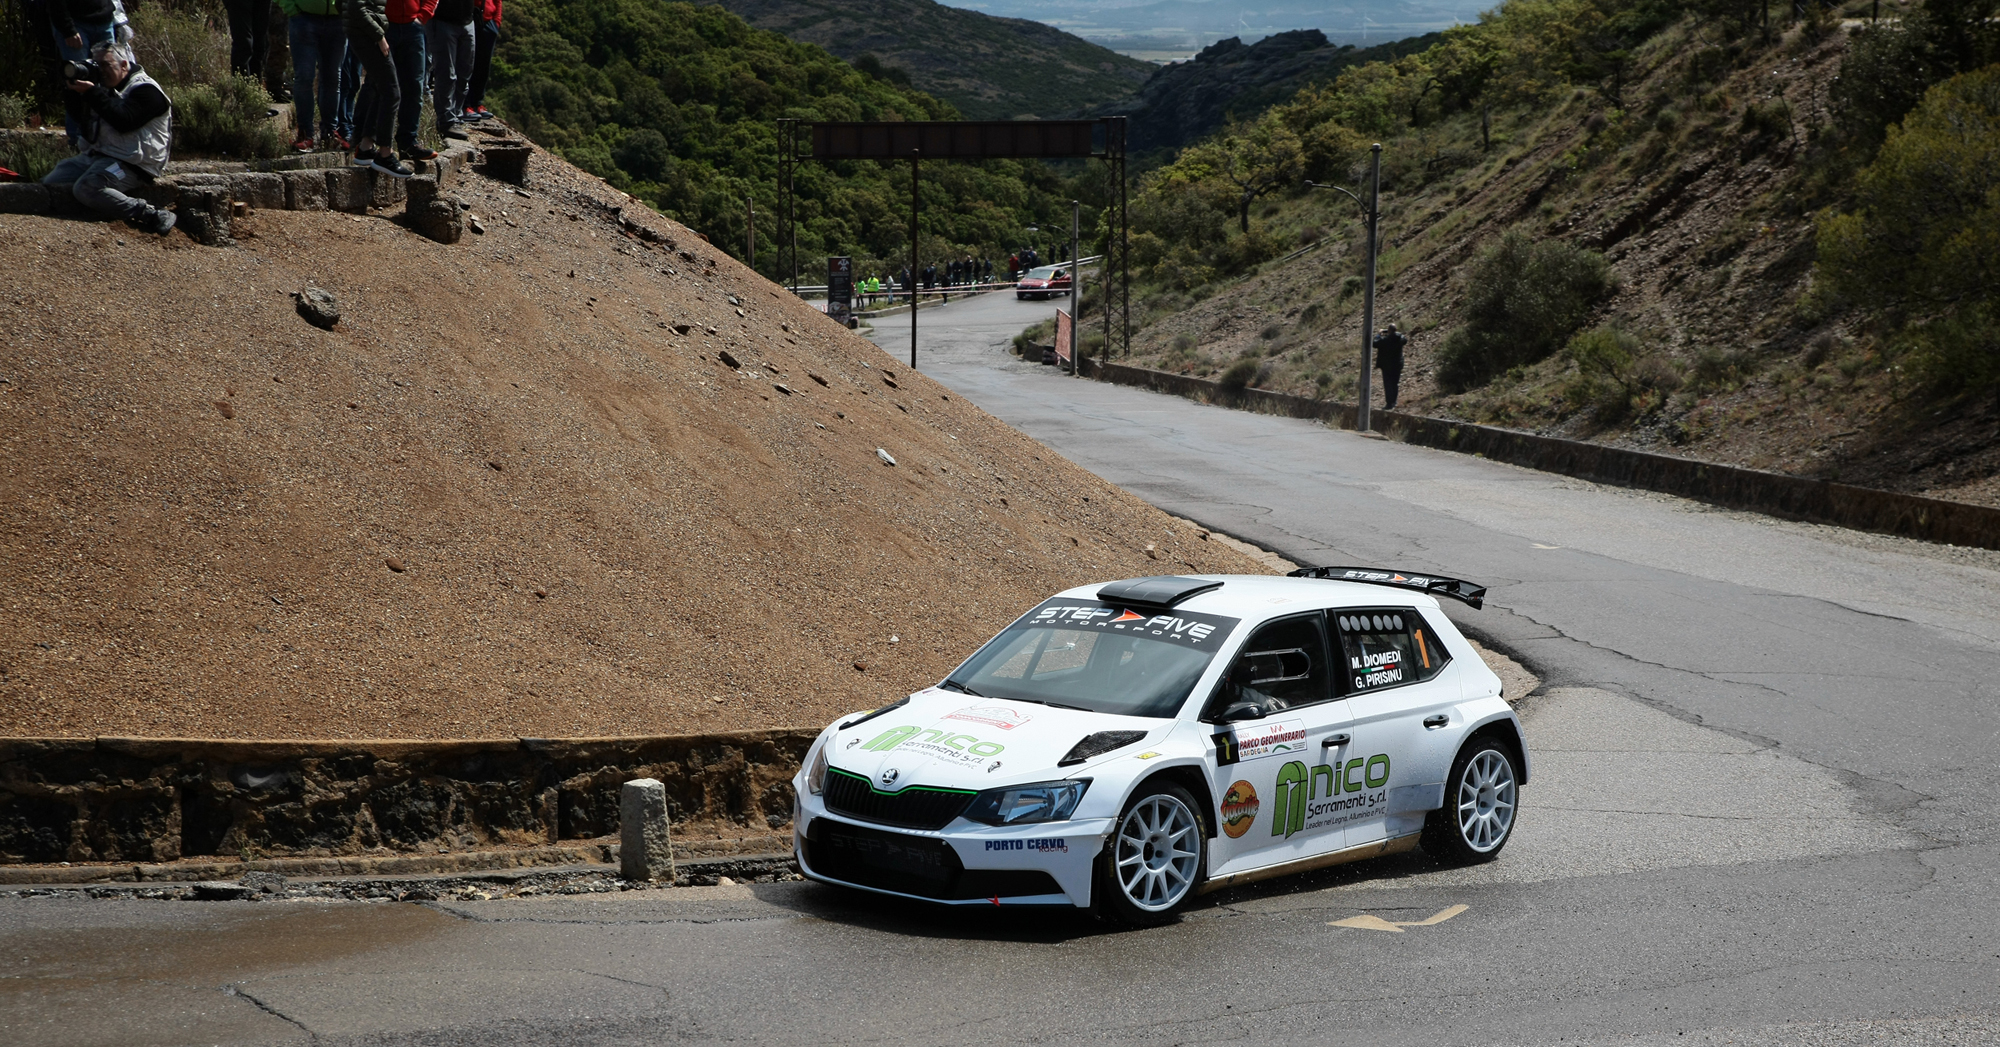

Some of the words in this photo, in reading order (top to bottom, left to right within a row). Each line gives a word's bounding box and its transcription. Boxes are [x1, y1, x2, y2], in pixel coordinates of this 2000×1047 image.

[1343, 571, 1389, 580] STEP
[1029, 619, 1202, 644] MOTORSPORT
[1035, 606, 1115, 619] STEP
[1145, 615, 1217, 639] FIVE
[1351, 656, 1362, 669] M.
[1363, 650, 1402, 668] DIOMEDI
[1414, 629, 1430, 669] 1
[1355, 676, 1365, 689] G.
[1366, 668, 1403, 687] PIRISINU
[1221, 736, 1231, 760] 1
[1240, 738, 1260, 750] PARCO
[1261, 730, 1306, 746] GEOMINERARIO
[1240, 747, 1269, 758] SARDEGNA
[1307, 793, 1366, 819] Serramenti
[1306, 820, 1323, 830] Leader
[1349, 810, 1371, 821] Alluminio
[1375, 807, 1386, 816] PVC
[985, 839, 1023, 851] PORTO
[1027, 838, 1065, 850] CERVO
[1038, 845, 1068, 853] Racing
